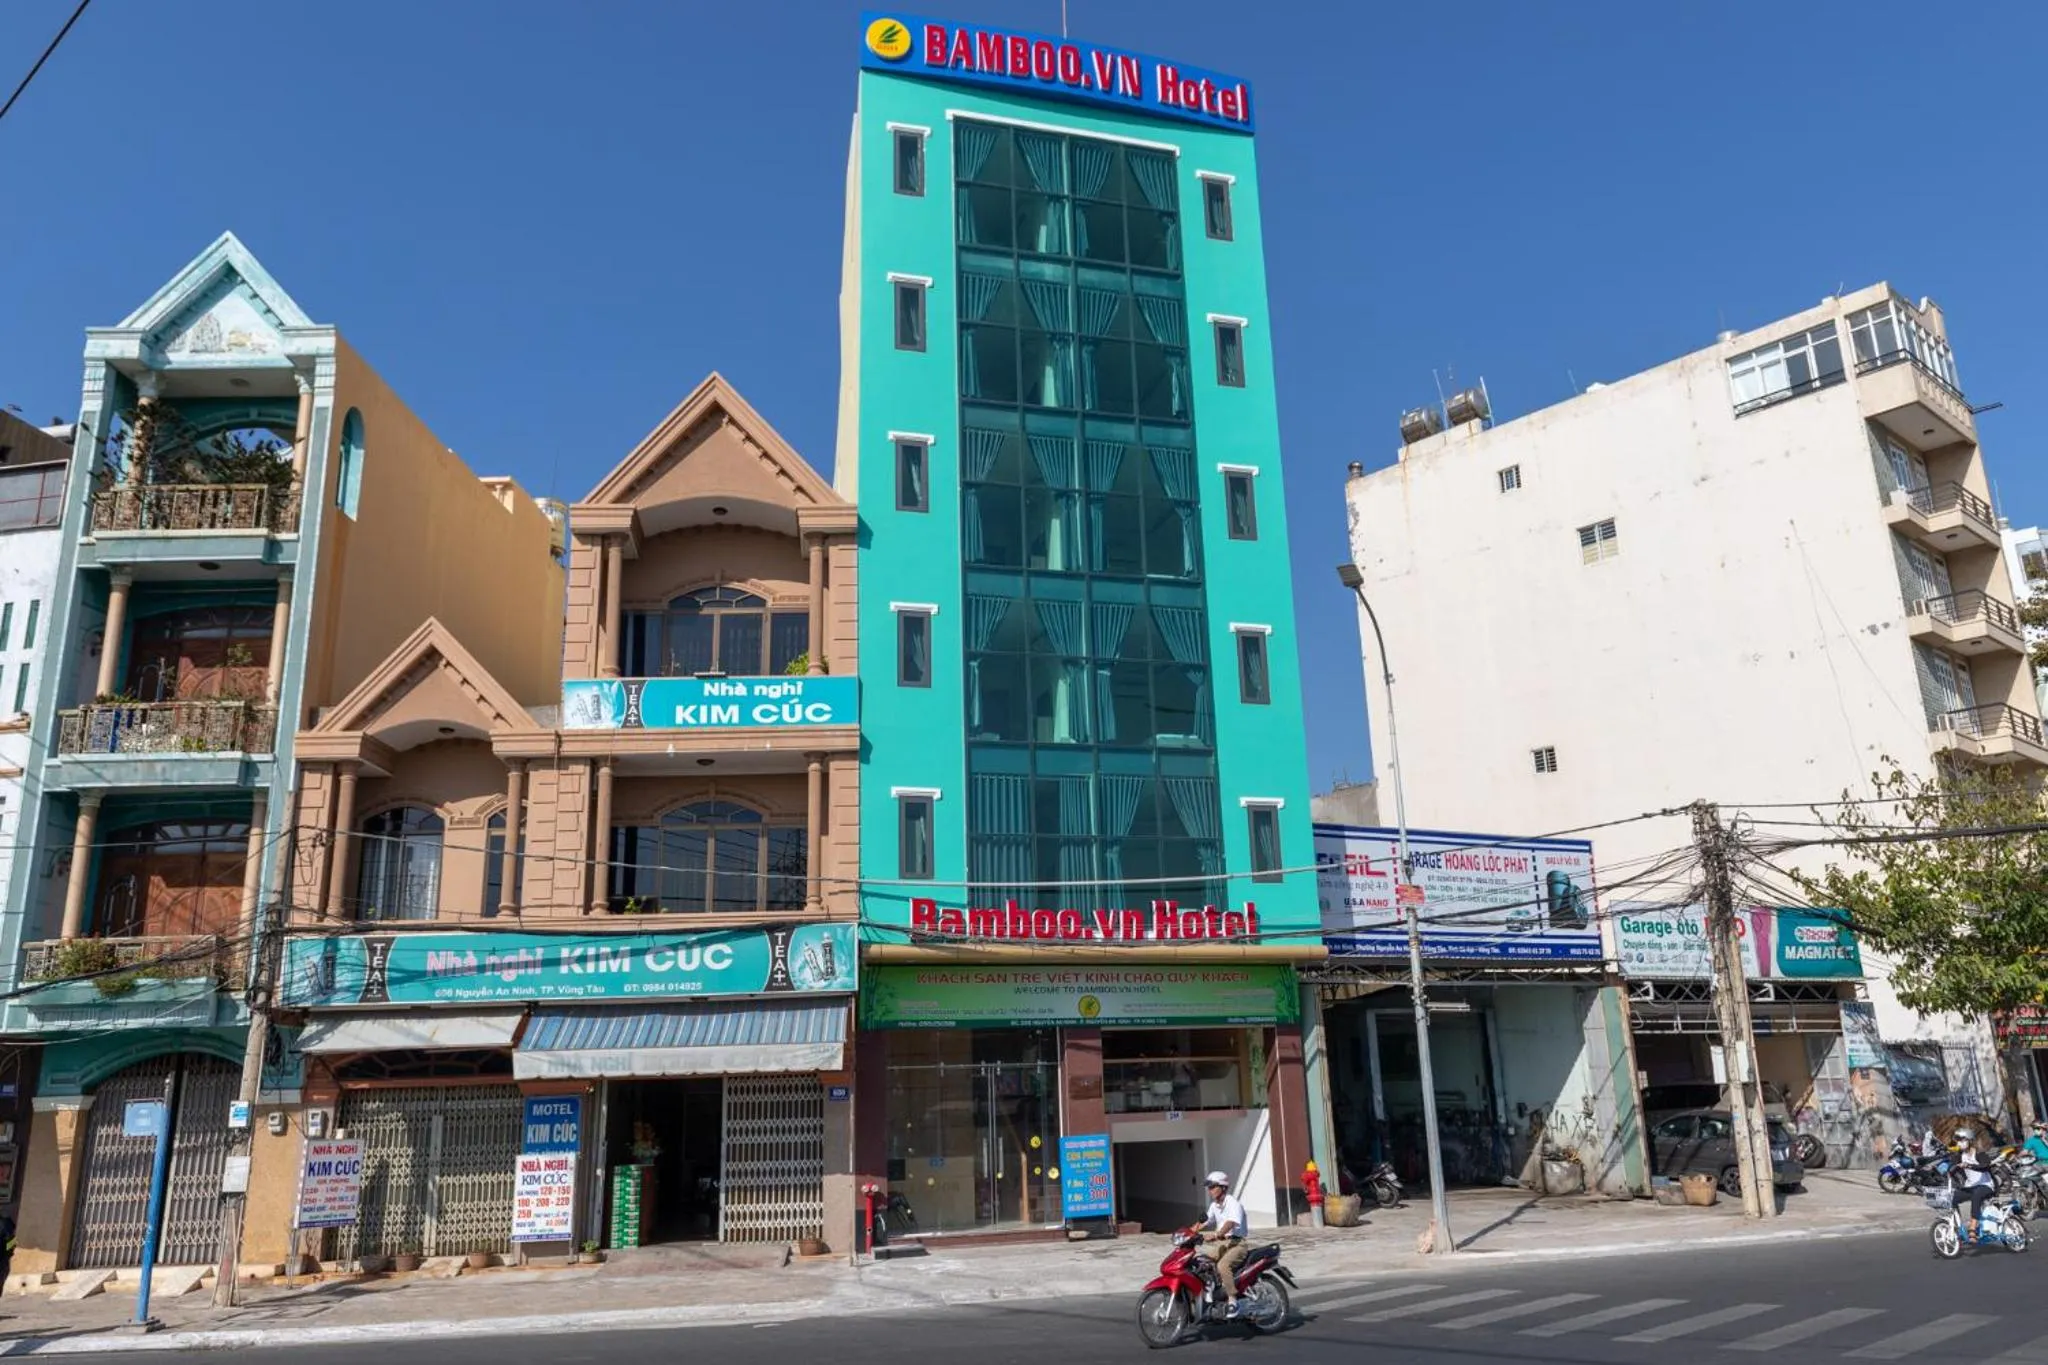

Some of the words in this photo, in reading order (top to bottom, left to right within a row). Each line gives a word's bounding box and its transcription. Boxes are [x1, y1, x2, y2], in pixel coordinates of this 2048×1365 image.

[924, 24, 1142, 97] BAMBOO.VN
[1156, 64, 1249, 121] Hotel
[703, 682, 748, 697] Nhà
[675, 704, 740, 725] KIM
[752, 698, 833, 724] CÚC
[1408, 850, 1442, 871] ARAGE
[909, 897, 1145, 941] Bamboo.vn
[1152, 899, 1258, 940] Hotel
[1620, 915, 1672, 938] Garage
[369, 943, 387, 994] TEA+
[559, 945, 631, 974] KIM
[773, 931, 786, 982] TEA+
[532, 1103, 574, 1116] MOTEL
[527, 1123, 551, 1145] KIM
[552, 1119, 577, 1143] CÚC
[308, 1160, 333, 1177] KIM
[335, 1157, 361, 1176] CÚC
[521, 1158, 542, 1172] NHÀ
[521, 1174, 542, 1186] KIM
